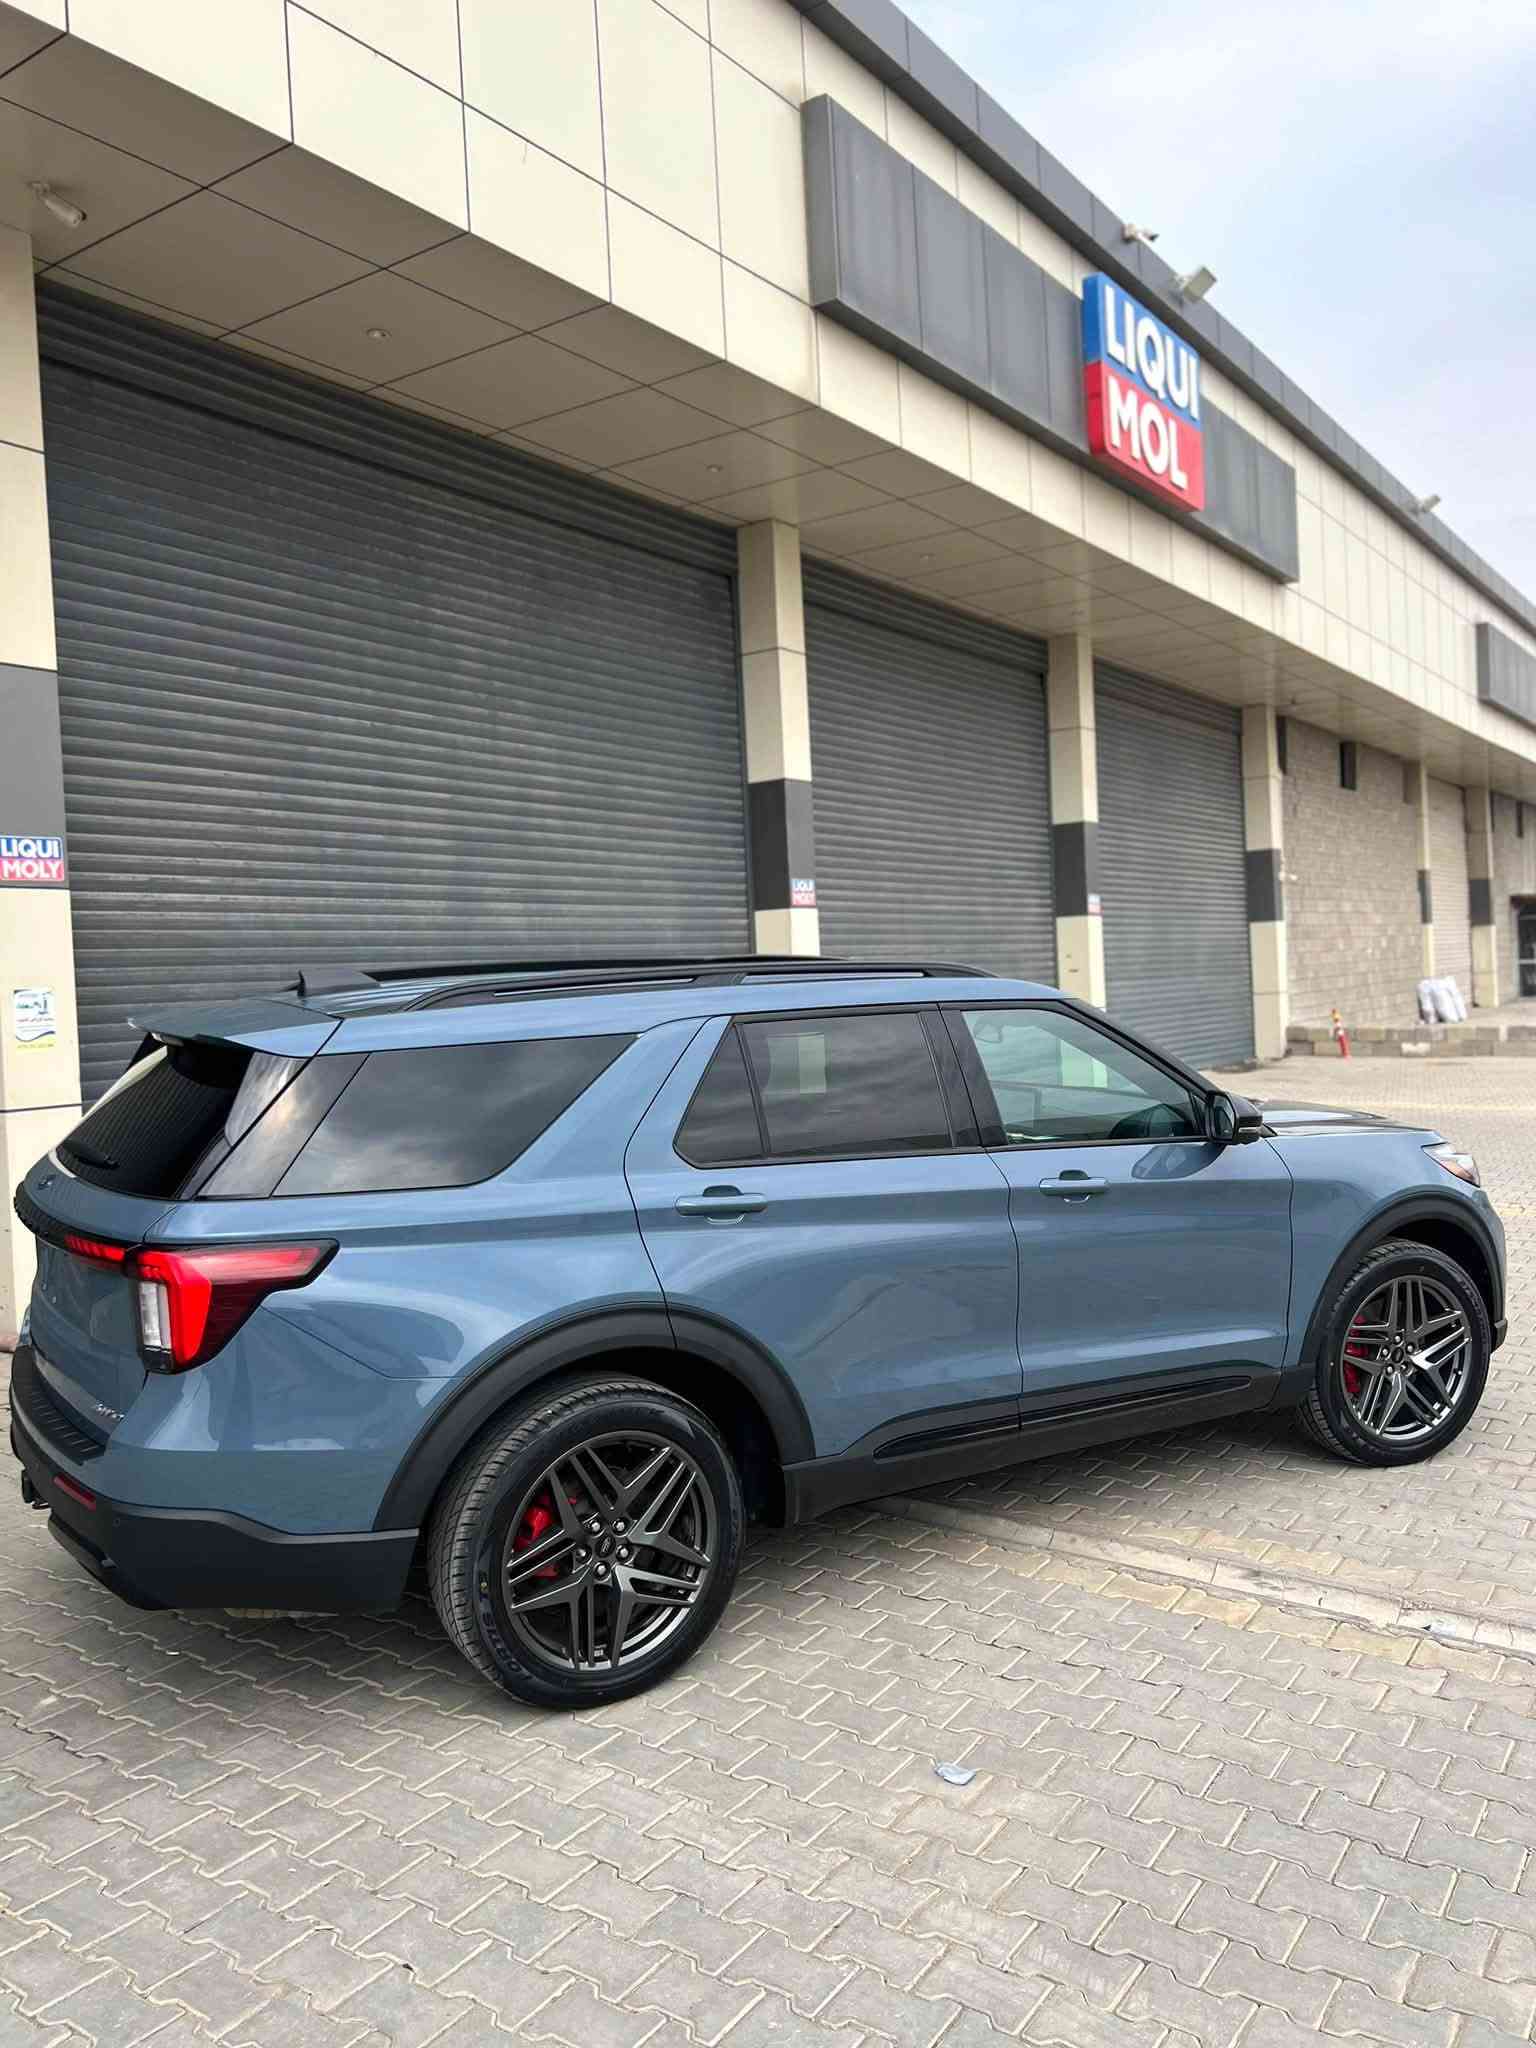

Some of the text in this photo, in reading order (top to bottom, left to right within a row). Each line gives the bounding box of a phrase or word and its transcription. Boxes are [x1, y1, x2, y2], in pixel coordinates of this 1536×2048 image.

[1104, 284, 1198, 420] LIQUI
[1108, 375, 1188, 489] MOL
[0, 838, 60, 858] LIQUI
[2, 860, 60, 879] MOLY
